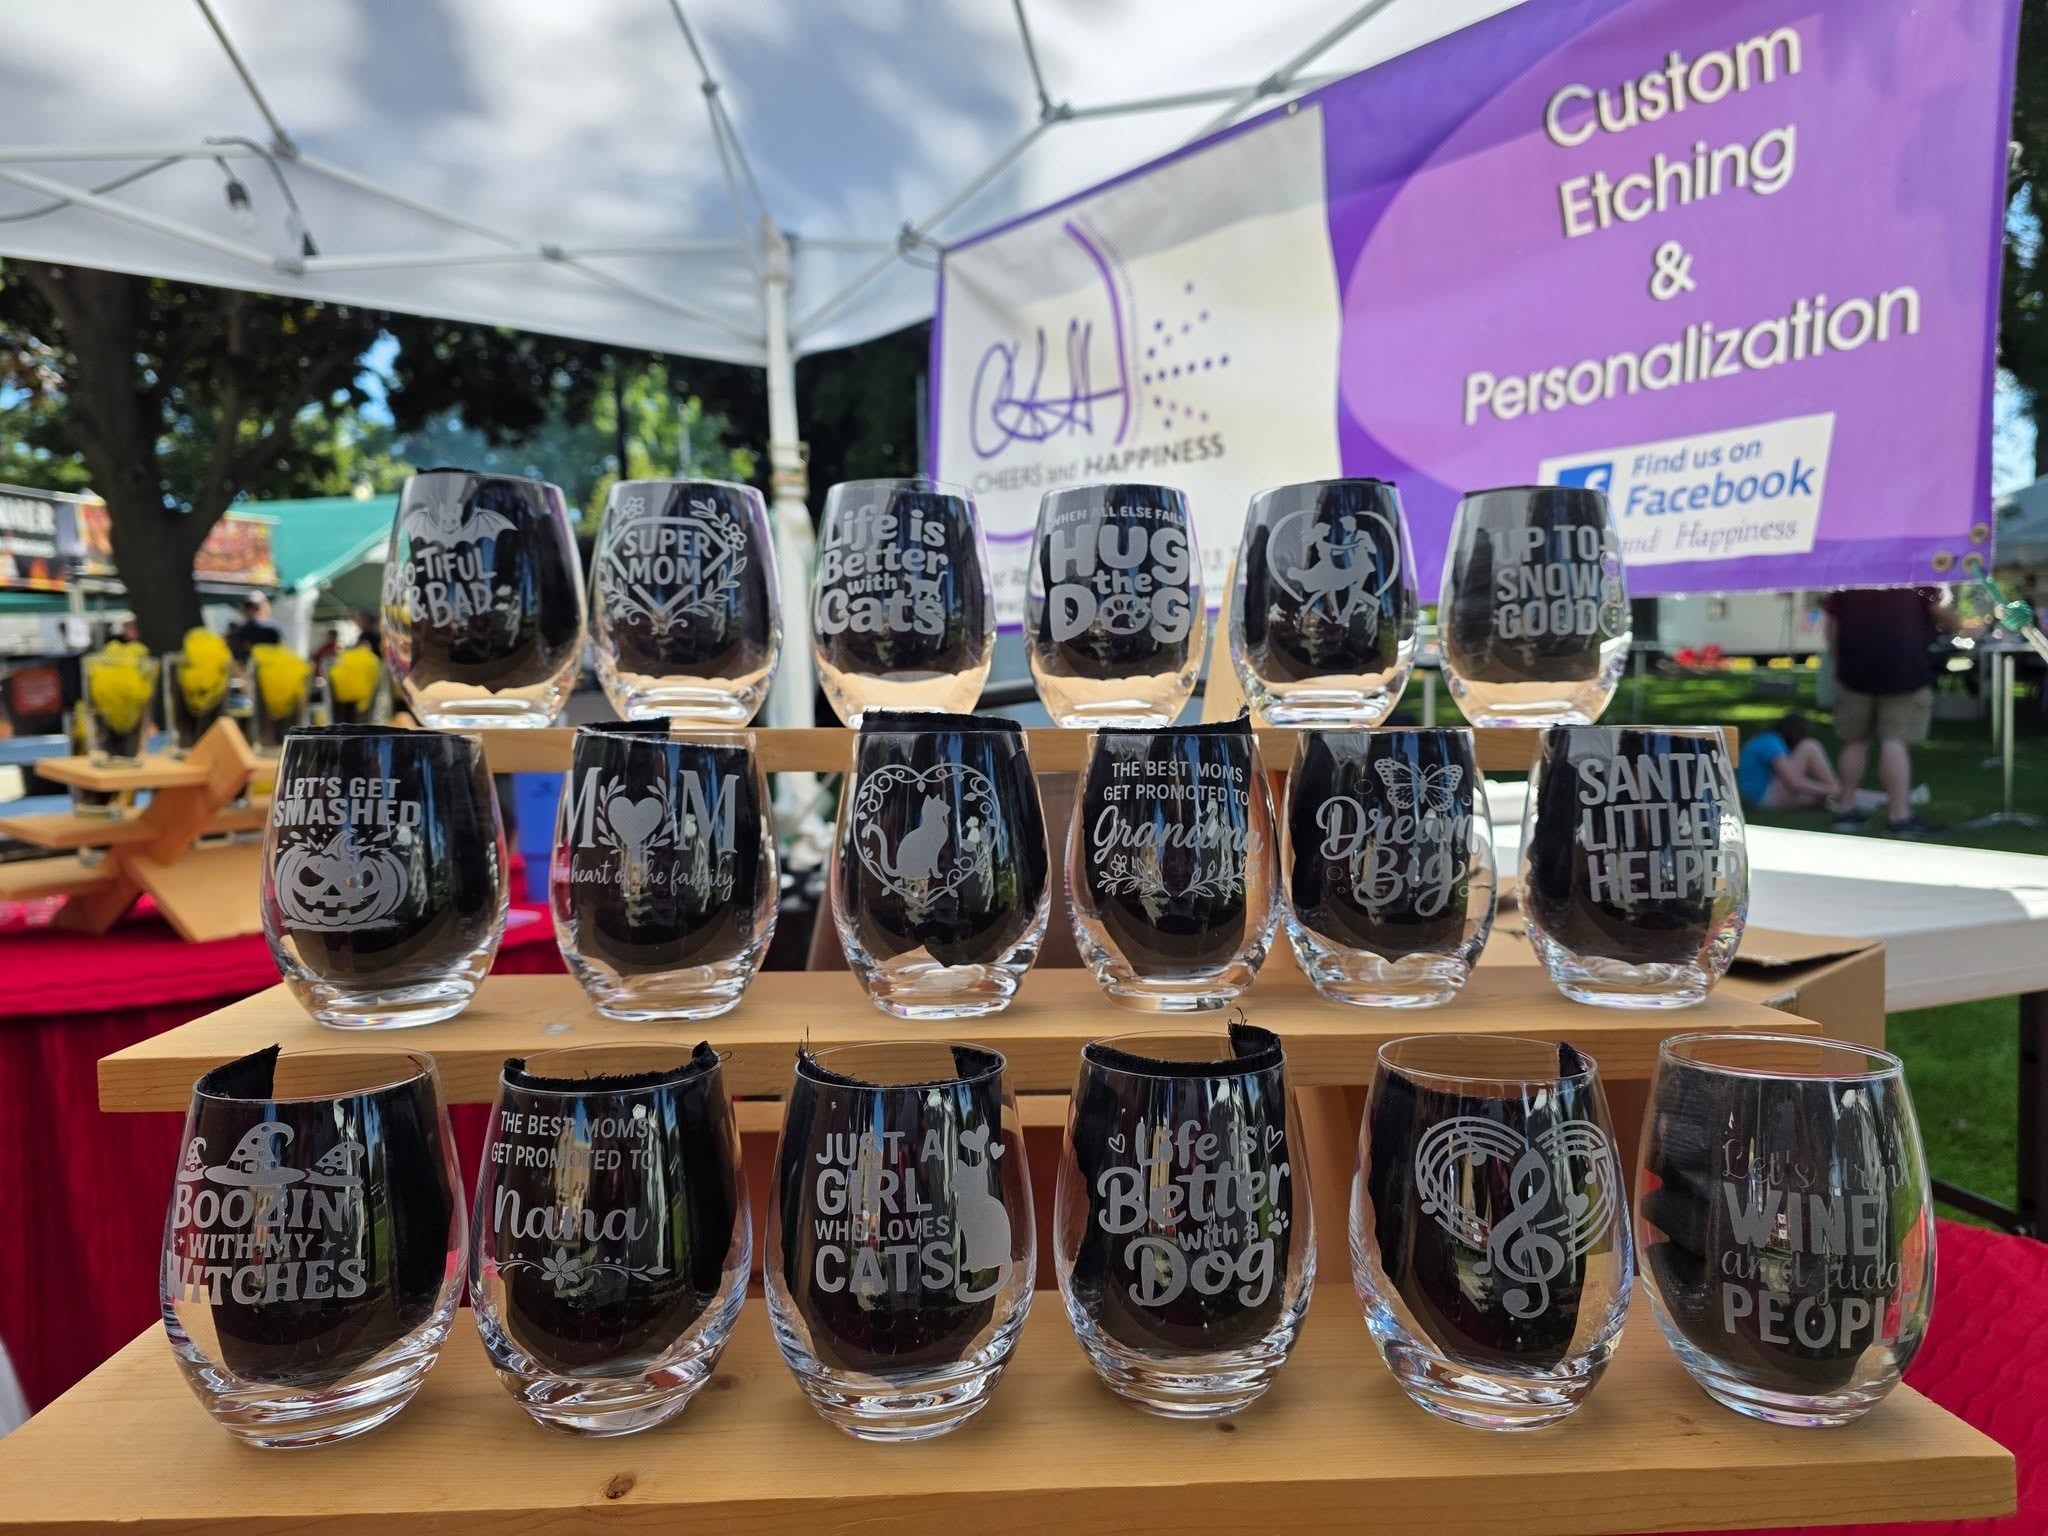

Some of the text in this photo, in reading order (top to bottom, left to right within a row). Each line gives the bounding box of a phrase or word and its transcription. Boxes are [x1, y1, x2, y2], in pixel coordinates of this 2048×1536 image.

[1546, 26, 1803, 147] Custom
[1559, 123, 1798, 239] Etching
[1648, 240, 1697, 301] &
[1463, 284, 1921, 426] Personalization
[973, 431, 1227, 494] CHEERS and HAPPINESS
[1631, 447, 1686, 479] Find
[1693, 447, 1722, 470] us
[1728, 438, 1763, 464] on
[1625, 456, 1816, 518] Facebook
[825, 503, 947, 552] Life is
[1051, 505, 1185, 527] WHEN ALL ELSE FAILS
[1674, 517, 1799, 554] Happiness
[622, 527, 713, 559] SUPER
[822, 541, 949, 587] Better
[1049, 523, 1190, 586] HUG
[1493, 524, 1600, 566] UP TO
[627, 555, 703, 586] MOM
[846, 572, 898, 596] with
[1092, 569, 1153, 595] the
[1496, 562, 1600, 602] SNOW
[425, 580, 494, 629] BAD
[820, 589, 947, 636] Cats
[1049, 583, 1191, 644] DOG
[1497, 598, 1599, 640] GOOD
[285, 775, 402, 800] LET'S GET
[1103, 784, 1251, 806] GET PROMOTED TO
[1111, 760, 1244, 783] THE BEST MOMS
[1577, 750, 1733, 806] SANTA'S
[273, 797, 422, 828] SMASHED
[1093, 804, 1265, 865] Grandma
[1315, 795, 1481, 861] Dream
[1581, 801, 1715, 851] LITTLE
[570, 853, 612, 886] heart
[670, 854, 737, 902] family
[1352, 846, 1467, 917] Big
[1587, 849, 1742, 903] HELPER
[500, 1110, 650, 1139] THE BEST MOMS
[815, 1128, 946, 1166] JUST A
[1134, 1119, 1260, 1170] Life is
[491, 1141, 655, 1171] GET PROMOTED TO
[1722, 1138, 1817, 1189] Let's
[816, 1167, 934, 1216] GIRL
[1097, 1160, 1292, 1235] Better
[815, 1214, 951, 1242] WHO LOVES
[1178, 1220, 1260, 1252] with a
[1722, 1181, 1880, 1256] WINE
[188, 1232, 315, 1260] WITH MY
[815, 1240, 955, 1294] CATS
[165, 1248, 368, 1307] WITCHES
[1124, 1236, 1275, 1308] Dog
[1721, 1281, 1920, 1350] PEOPLE
